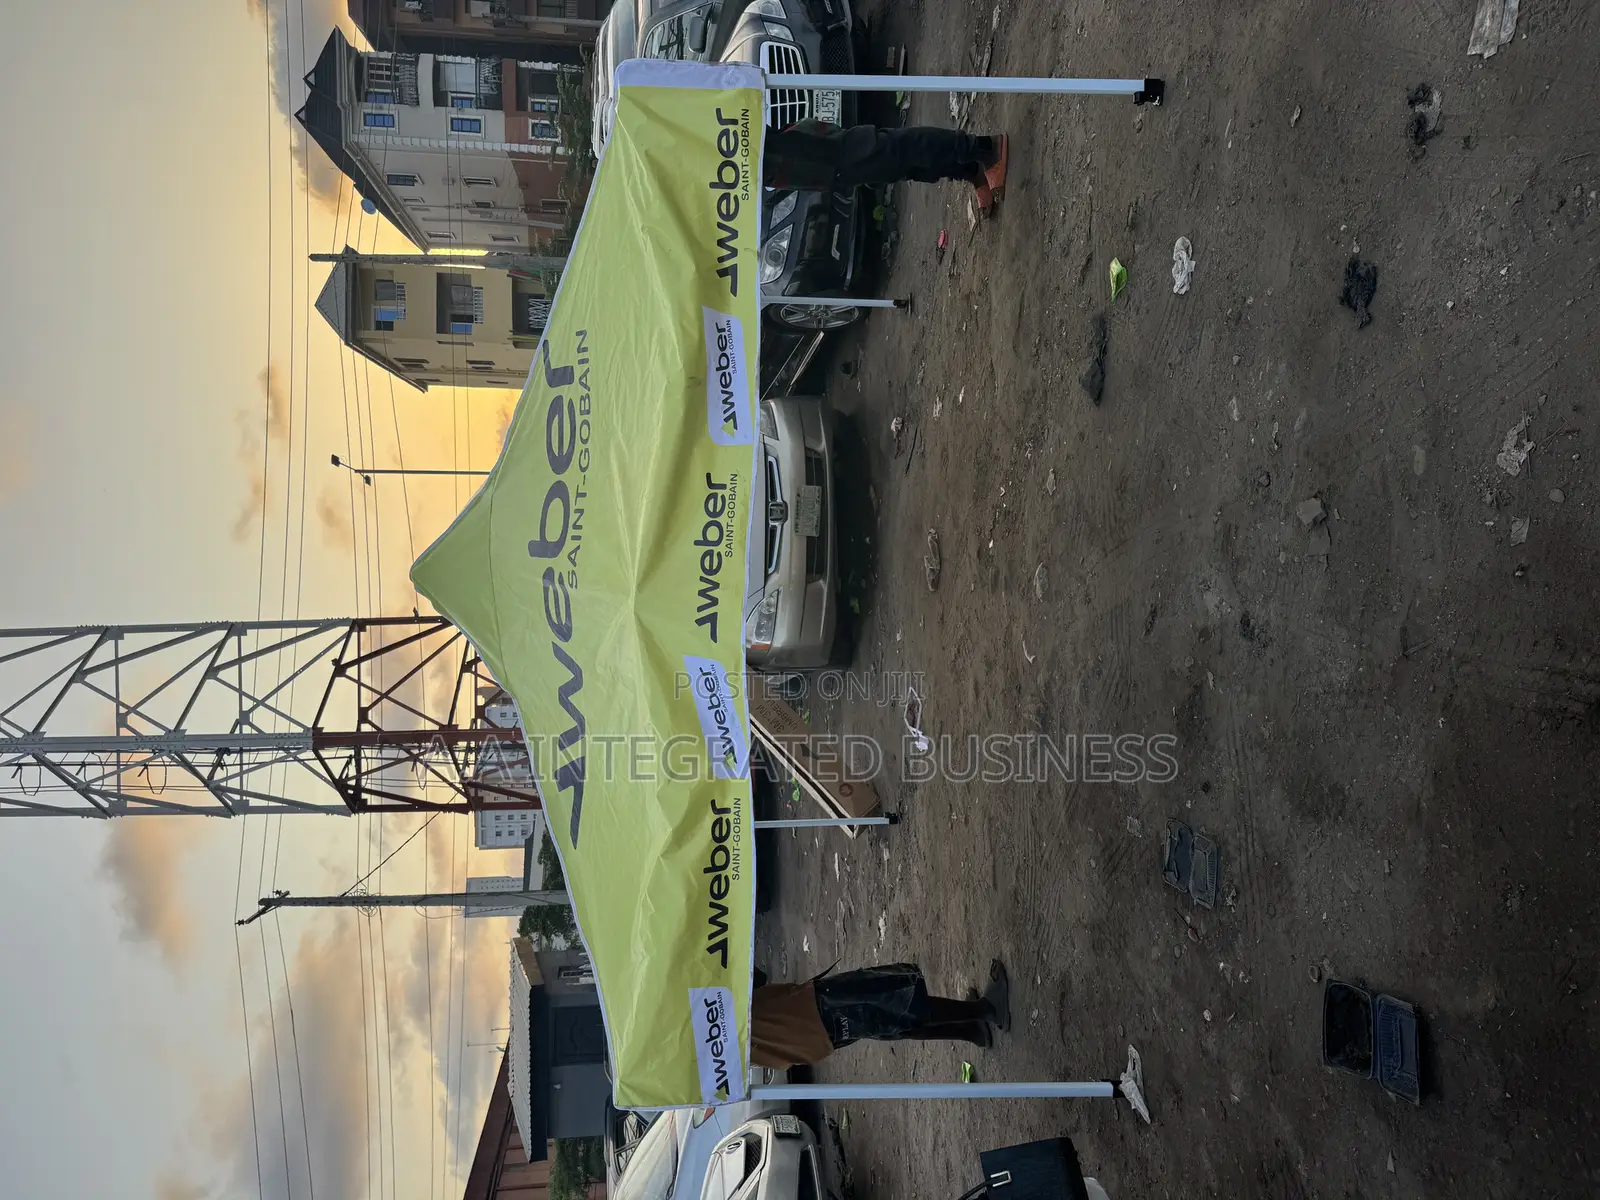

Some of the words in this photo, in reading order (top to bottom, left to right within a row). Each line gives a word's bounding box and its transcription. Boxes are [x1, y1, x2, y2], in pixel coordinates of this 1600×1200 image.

[709, 108, 740, 263] weber
[741, 108, 750, 200] SAINT-GOBAIN
[715, 322, 736, 414] weber
[726, 320, 738, 374] SAINT-GOBAIN
[566, 329, 592, 590] SAINT-GOBAIN
[527, 339, 586, 753] weber
[694, 472, 727, 613] weber
[724, 473, 738, 558] SAINT-GOBAIN
[699, 667, 732, 748] weber
[703, 799, 731, 940] weber
[732, 798, 741, 880] SAINT-GOBAIN
[704, 998, 728, 1083] weber
